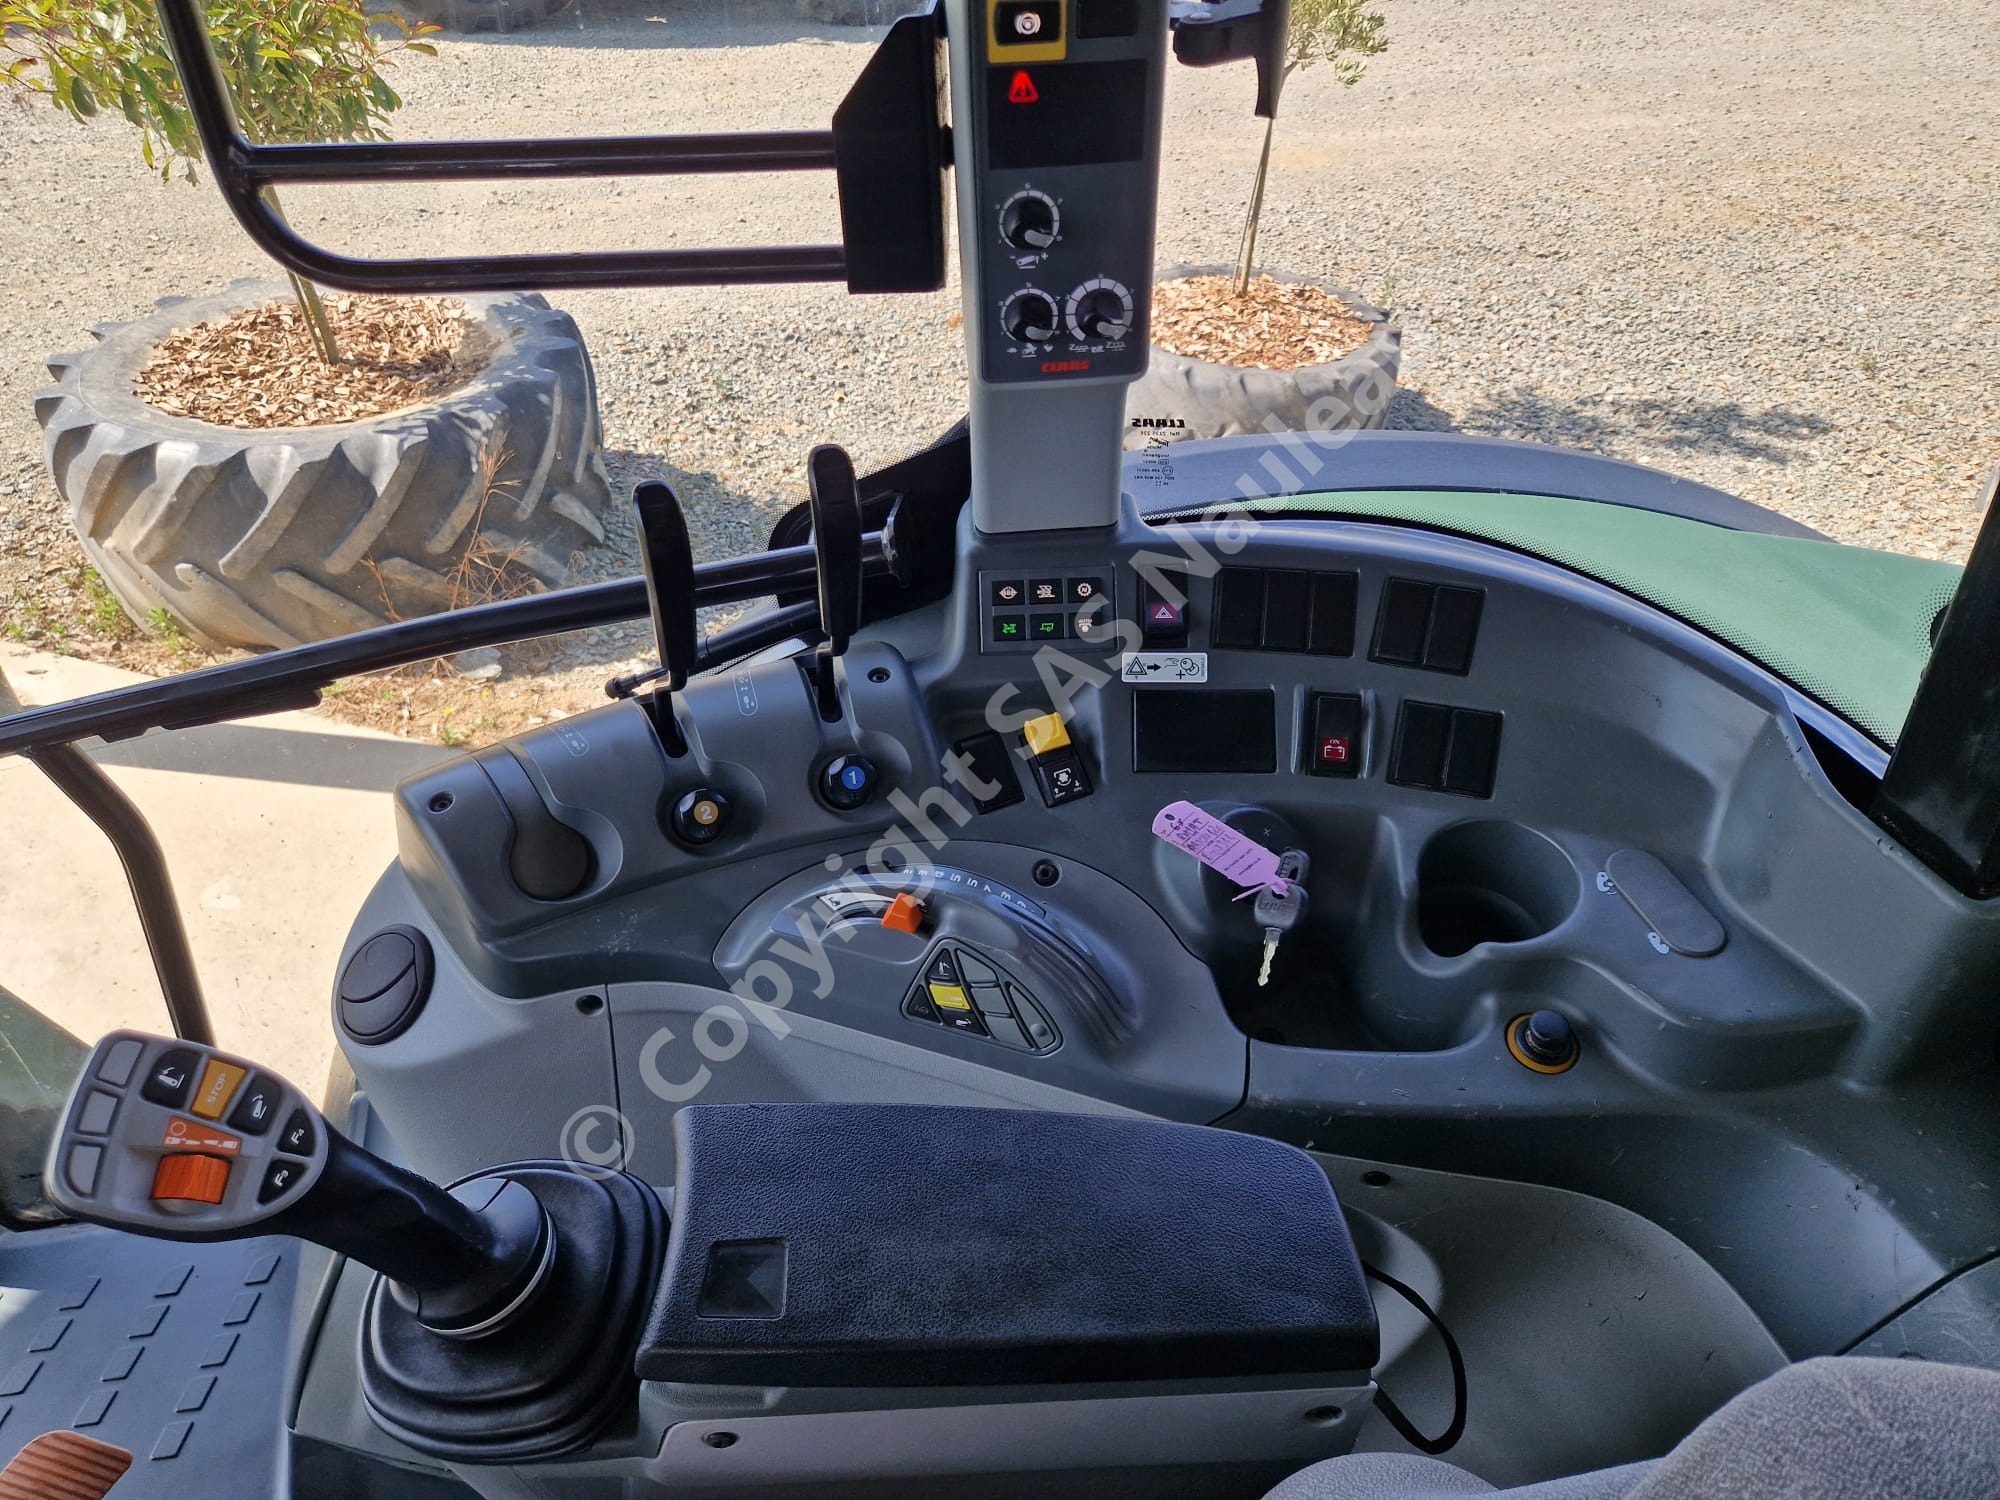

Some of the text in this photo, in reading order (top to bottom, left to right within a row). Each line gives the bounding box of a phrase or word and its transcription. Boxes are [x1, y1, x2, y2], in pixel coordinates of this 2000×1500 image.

[849, 771, 858, 785] 1
[700, 806, 713, 820] 2
[208, 1072, 227, 1105] STOP
[290, 1128, 305, 1145] F4
[274, 1169, 289, 1187] F3
